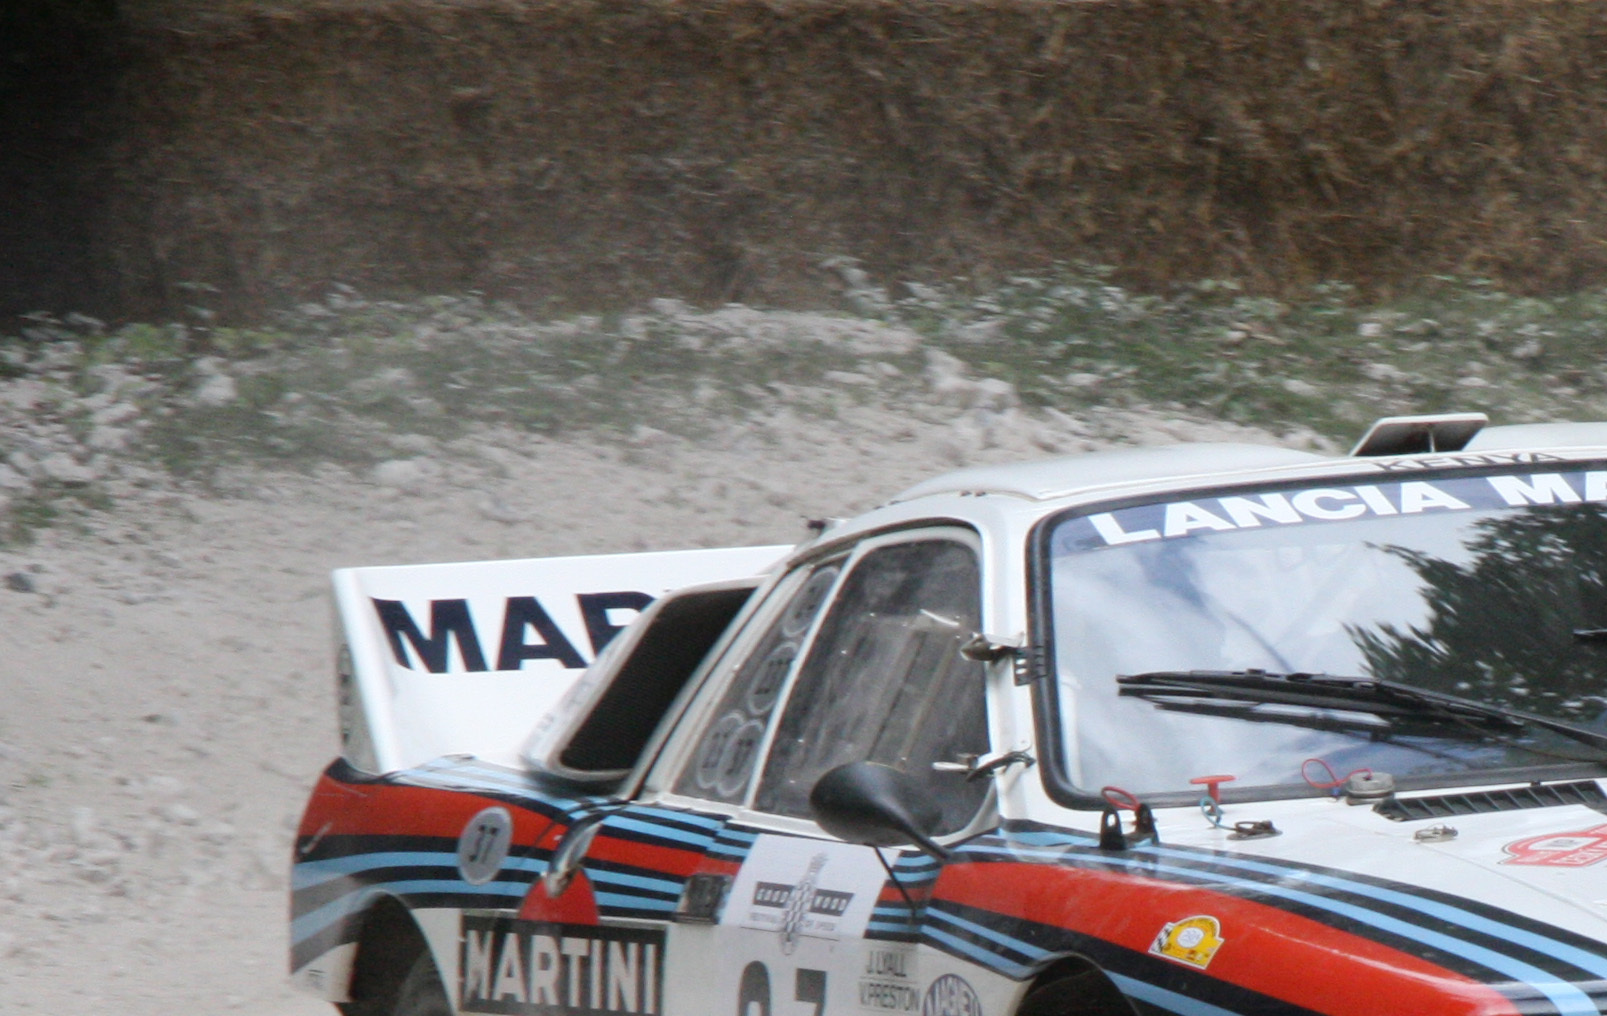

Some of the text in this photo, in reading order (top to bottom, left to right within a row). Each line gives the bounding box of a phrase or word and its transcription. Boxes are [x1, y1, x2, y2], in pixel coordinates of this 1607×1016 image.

[1373, 453, 1569, 472] KENYA
[1088, 481, 1471, 545] LANCIA
[465, 929, 657, 1015] MARTINI
